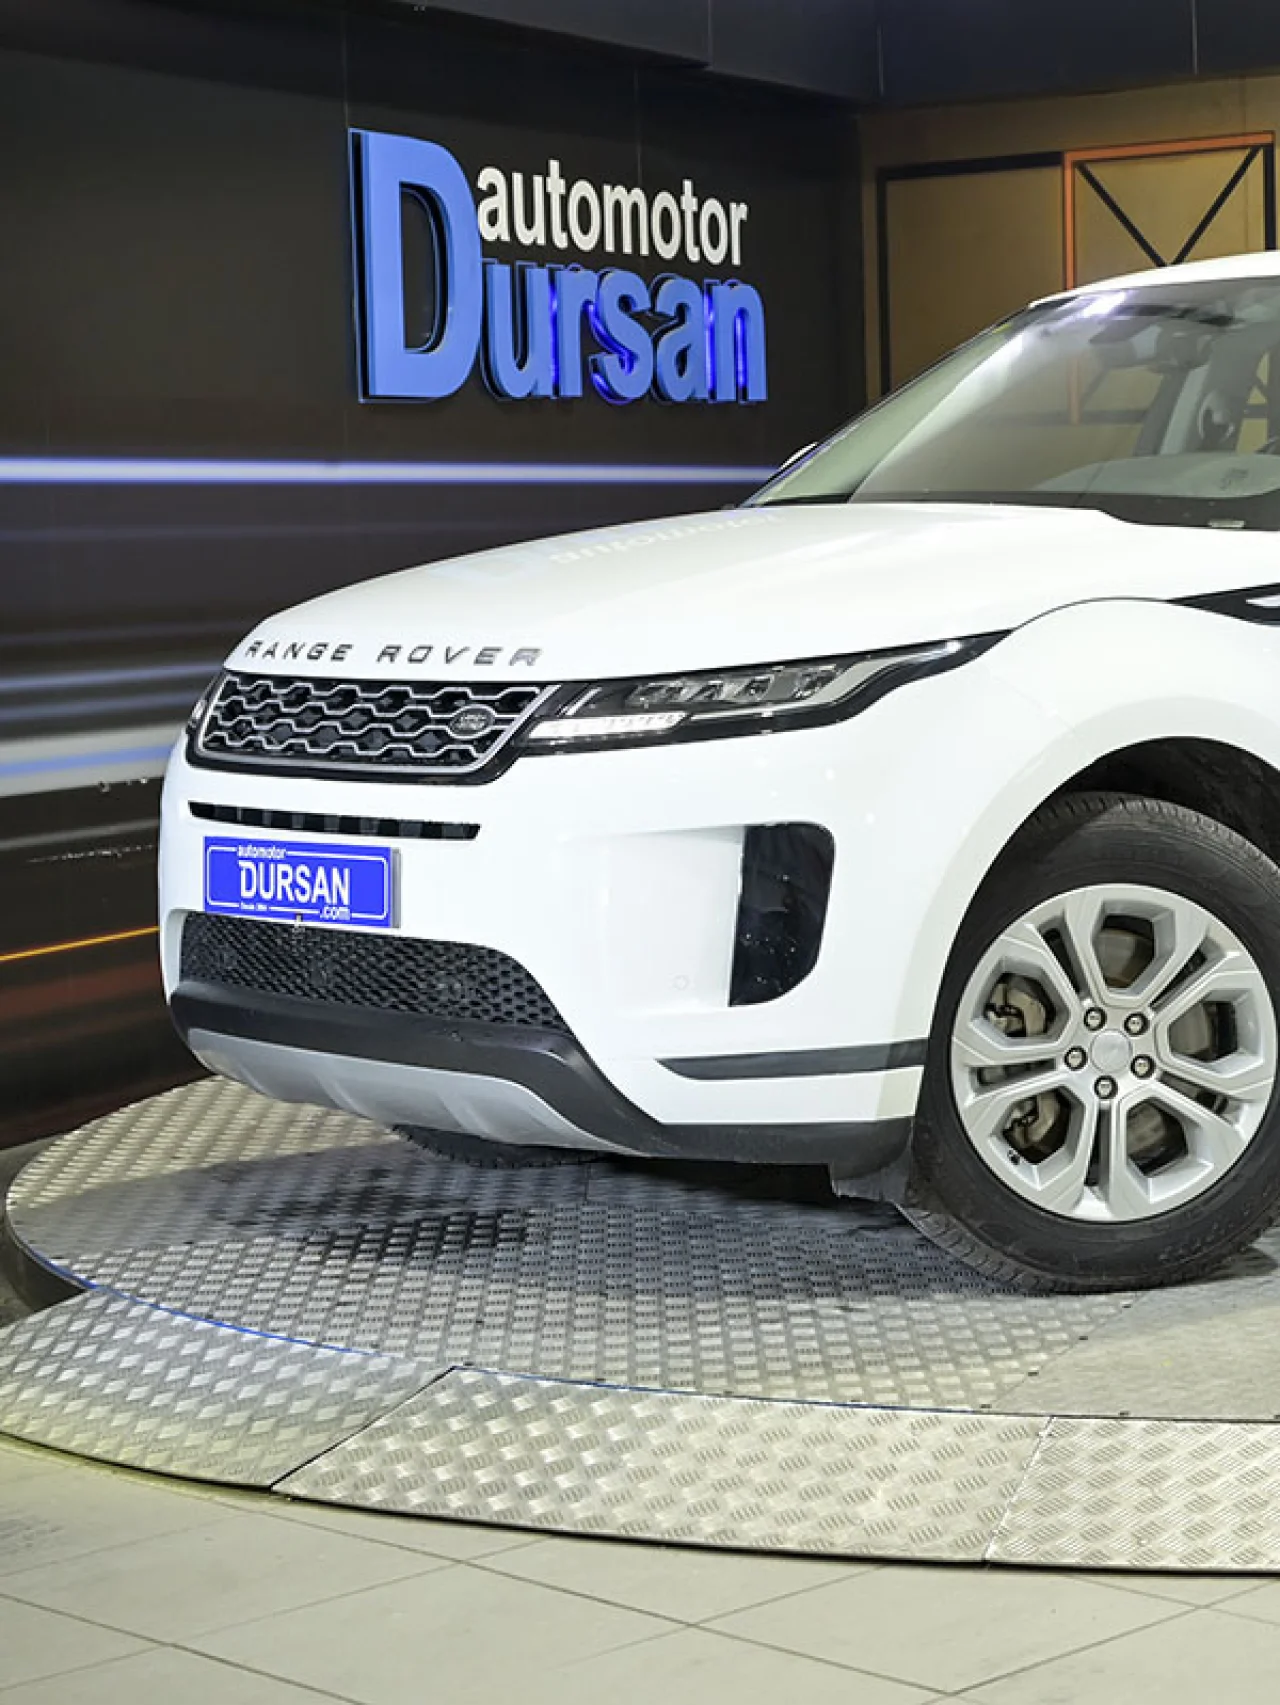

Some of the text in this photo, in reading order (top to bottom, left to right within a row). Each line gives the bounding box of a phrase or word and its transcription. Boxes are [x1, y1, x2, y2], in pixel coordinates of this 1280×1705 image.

[477, 160, 748, 266] automotor
[350, 127, 768, 403] Dursan
[245, 640, 543, 667] RANGE ROVER
[236, 844, 287, 859] automotor
[237, 859, 350, 906] DURSAN
[319, 905, 351, 921] .com
